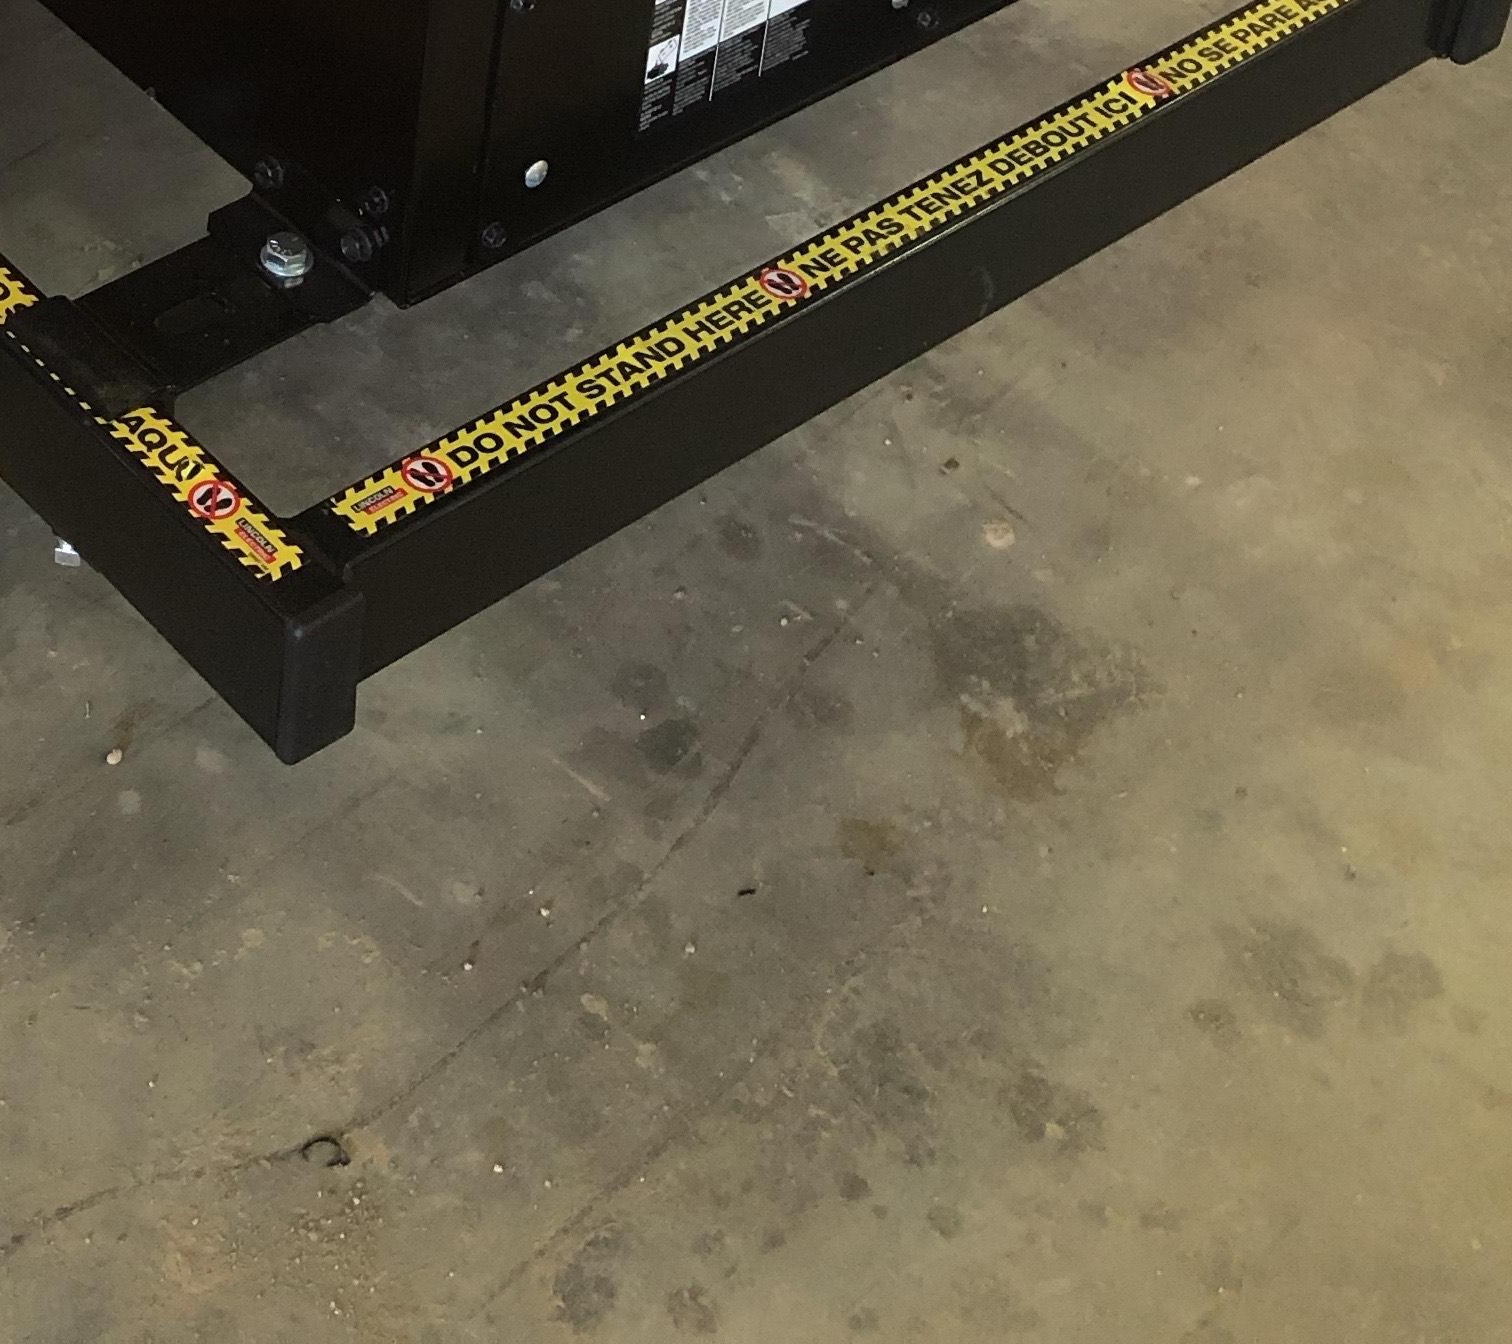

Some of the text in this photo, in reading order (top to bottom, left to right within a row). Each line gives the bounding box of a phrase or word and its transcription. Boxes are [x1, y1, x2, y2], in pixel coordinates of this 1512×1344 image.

[447, 430, 505, 468] DO
[502, 391, 578, 439] NOT
[576, 335, 686, 399] STAND
[682, 288, 774, 343] HERE
[798, 247, 840, 281] NE
[842, 216, 906, 256] PAS
[897, 167, 996, 223] TENEZ
[987, 113, 1098, 177] DEBOUT
[1097, 90, 1139, 128] ICI
[1158, 57, 1204, 85] NO
[1197, 37, 1240, 65] SE
[1234, 4, 1300, 47] PARE
[238, 519, 276, 554] LINCOLN
